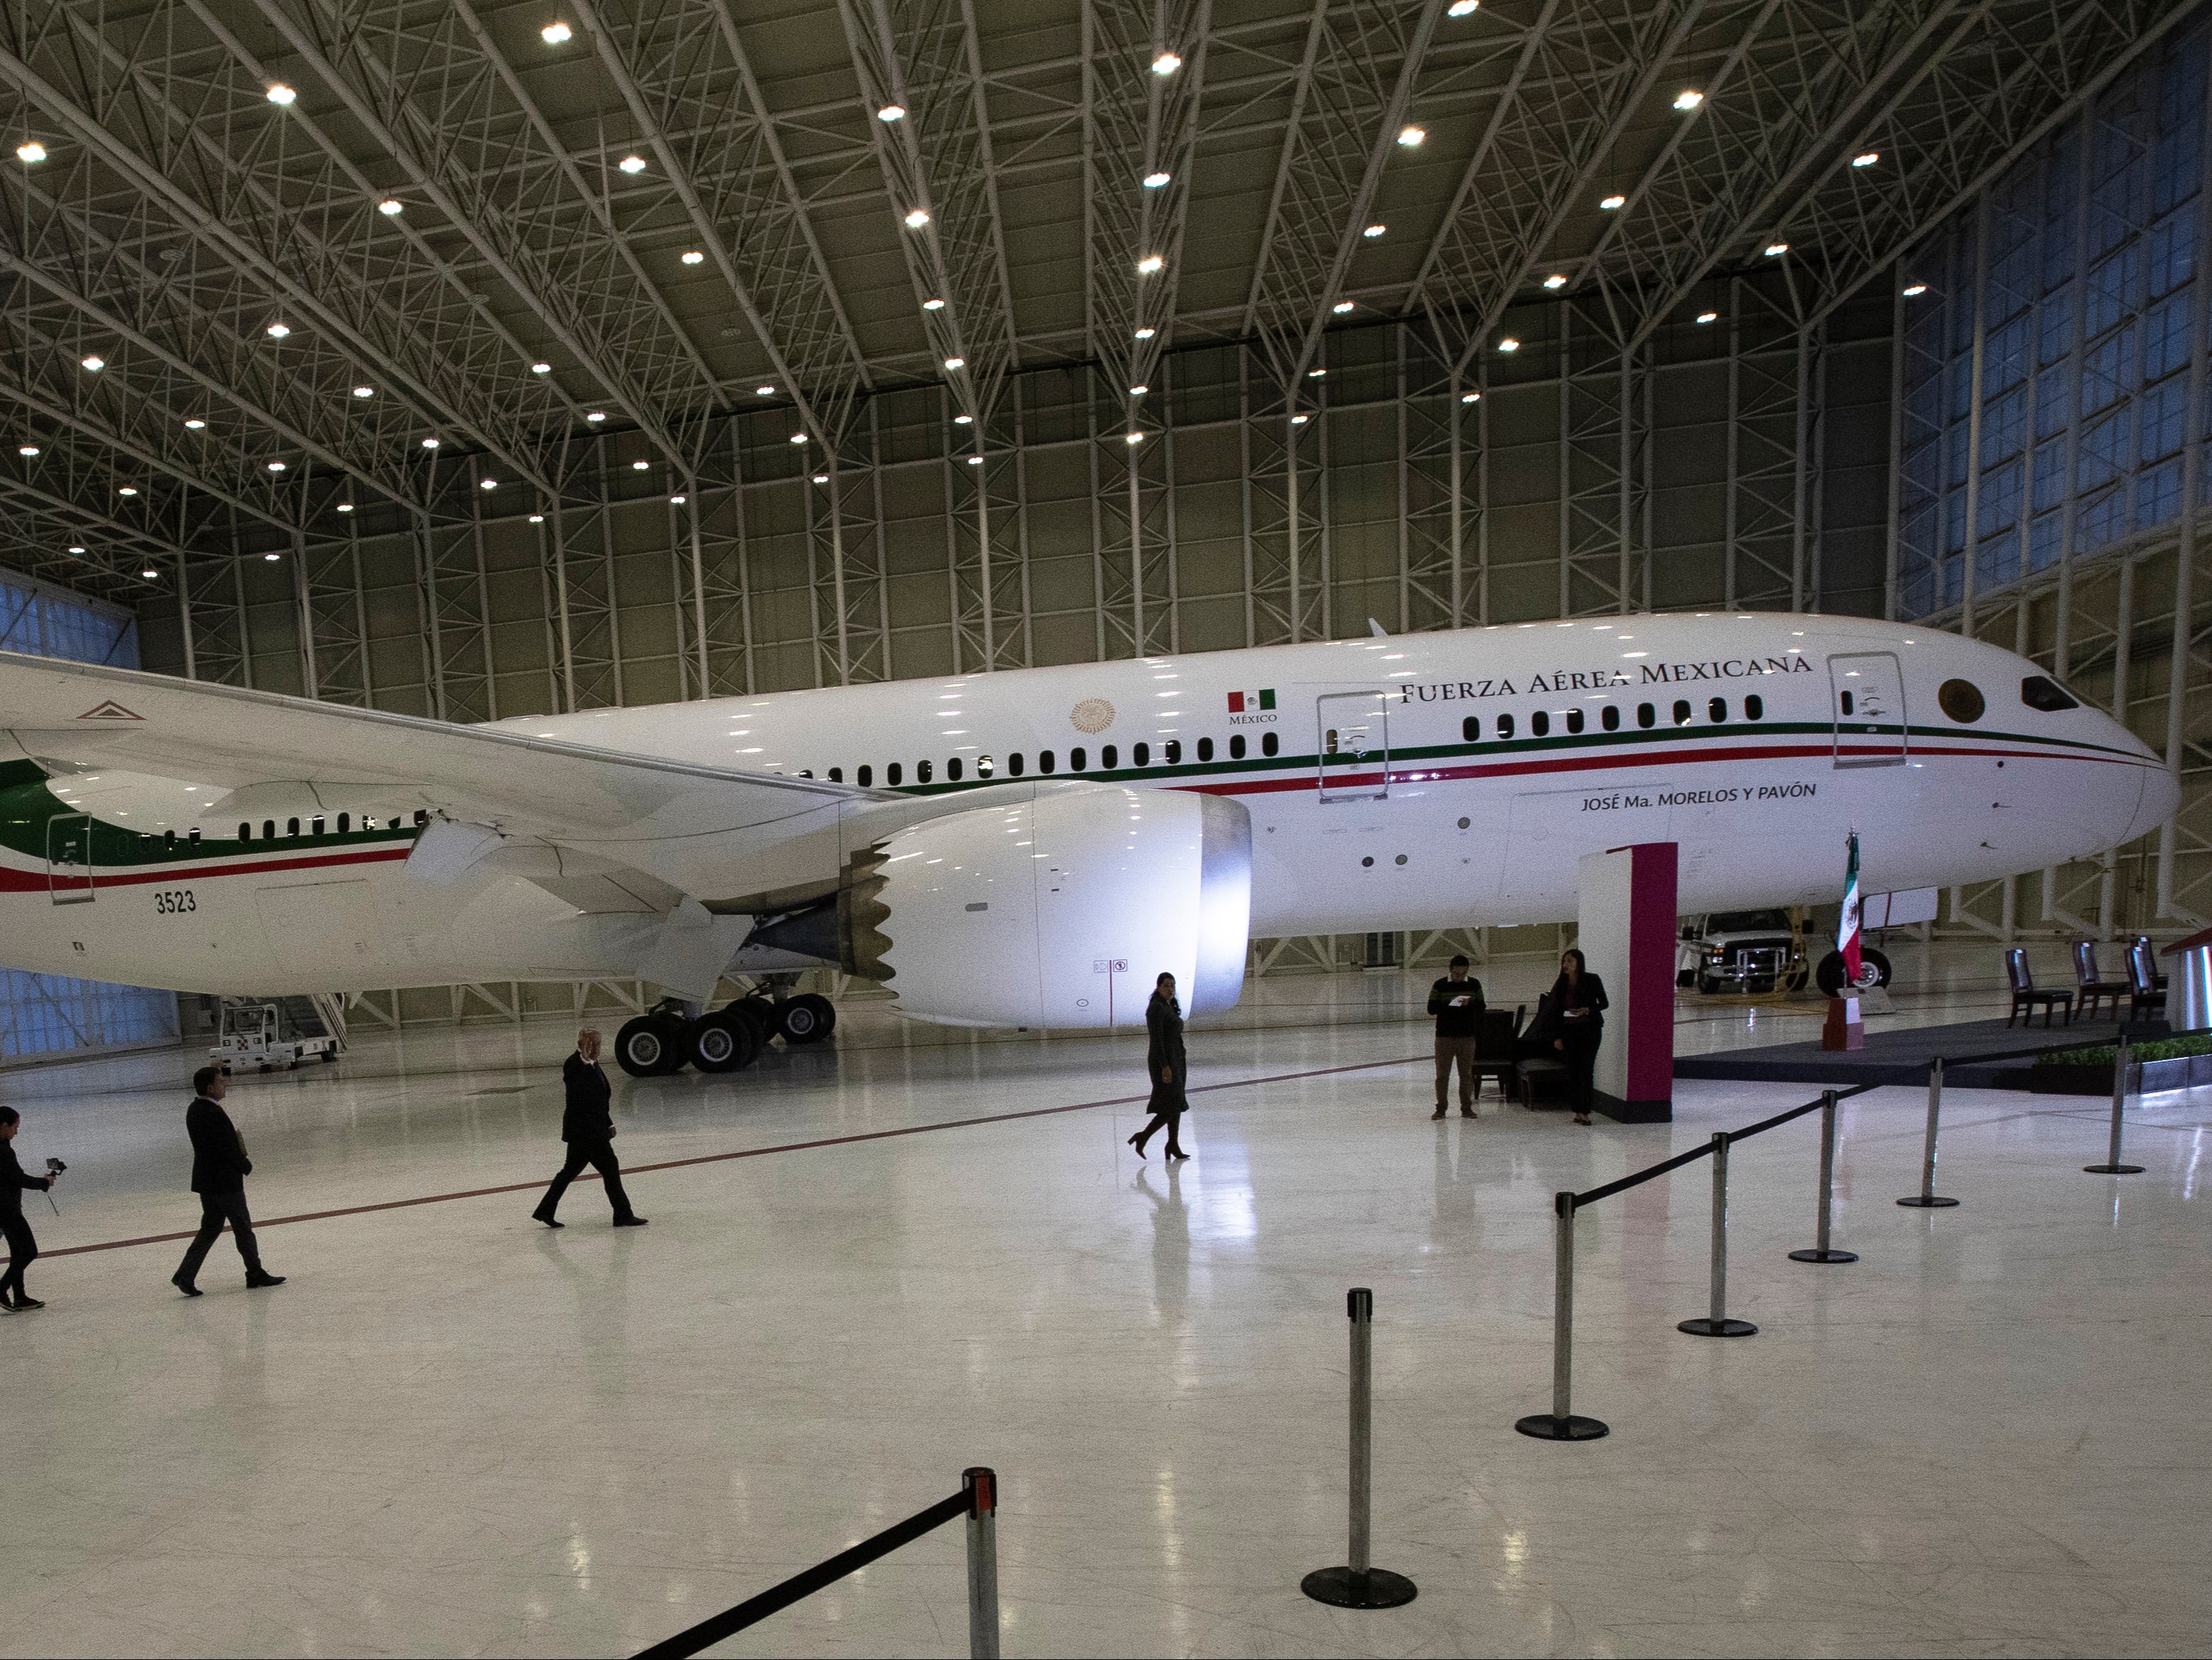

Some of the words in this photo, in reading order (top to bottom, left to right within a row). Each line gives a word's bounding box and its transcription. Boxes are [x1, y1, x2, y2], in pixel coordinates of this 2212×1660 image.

[1229, 715, 1277, 725] MÉXICO
[1581, 794, 1620, 811] JOSÉ
[1624, 796, 1652, 808] Ma.
[1658, 789, 1737, 807] MORELOS
[1743, 788, 1754, 800] Y
[1758, 781, 1817, 799] PAVÓN
[155, 890, 196, 914] 3523
